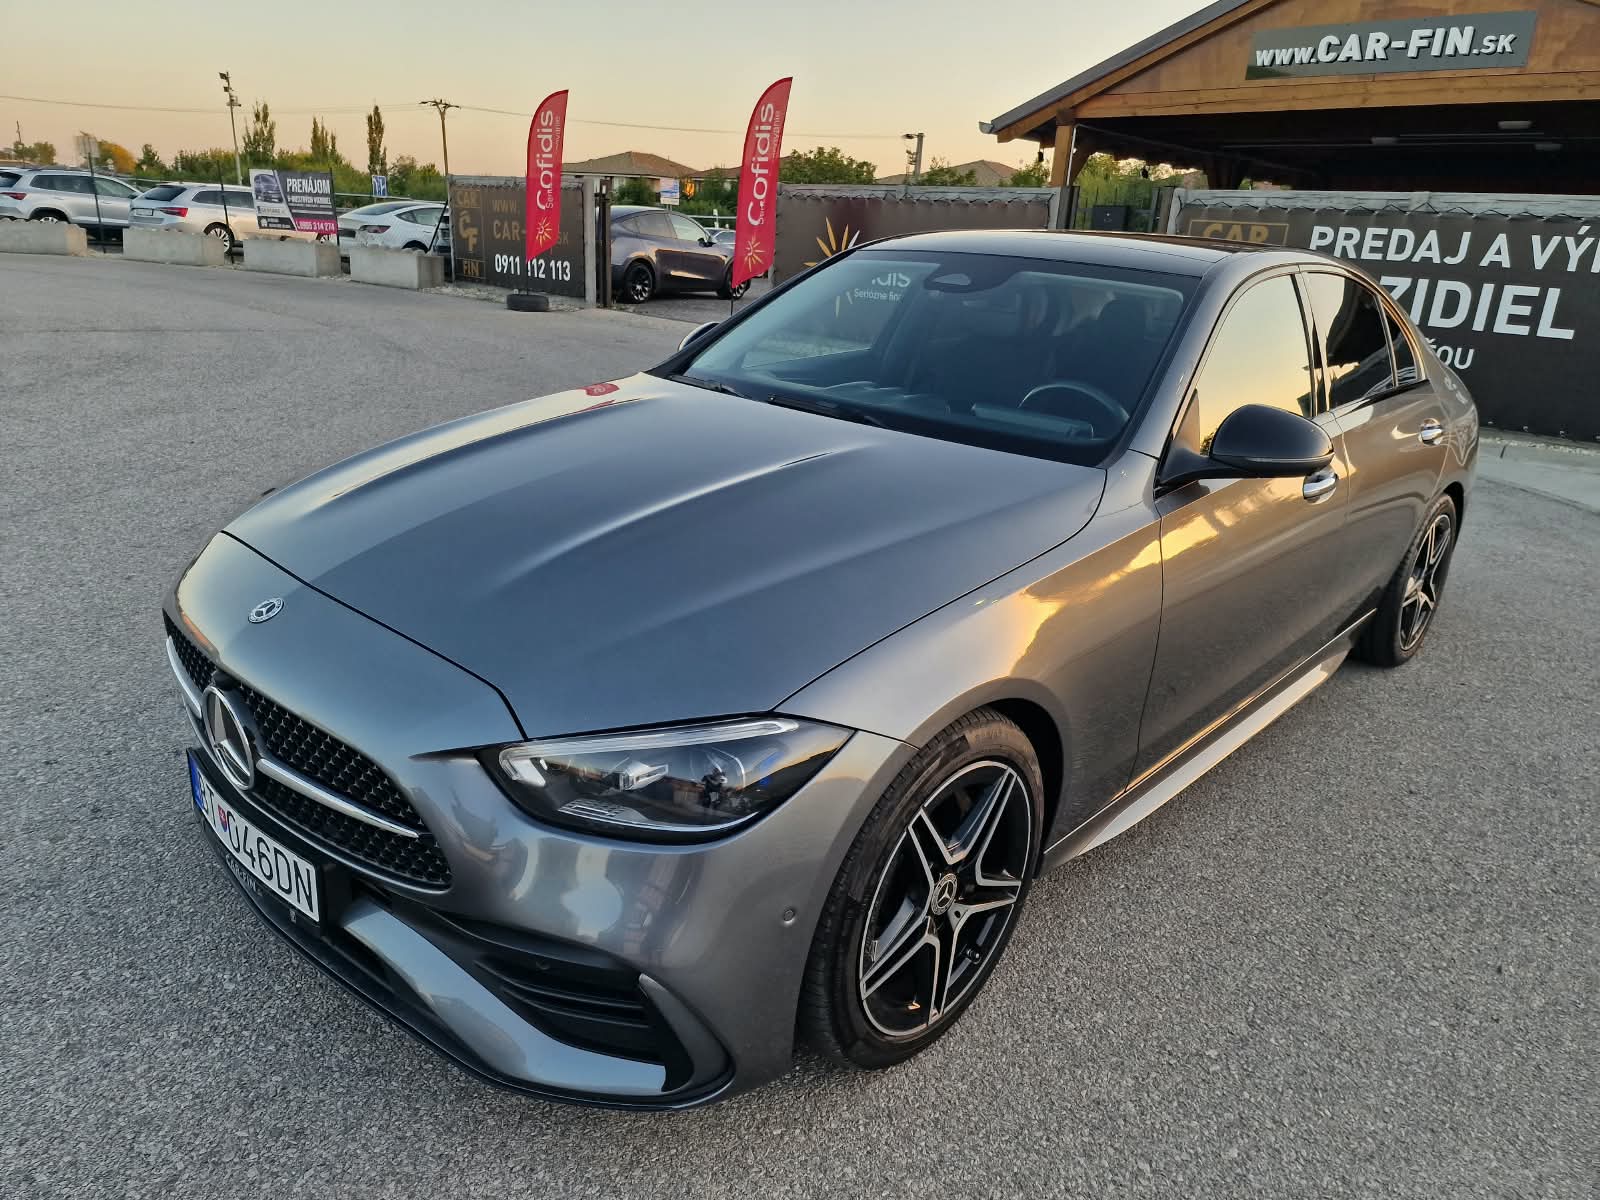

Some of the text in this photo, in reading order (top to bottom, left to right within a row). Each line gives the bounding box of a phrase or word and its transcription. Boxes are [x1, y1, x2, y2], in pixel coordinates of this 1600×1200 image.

[536, 109, 554, 211] Cofidis
[747, 102, 774, 226] Cofidis
[286, 176, 331, 194] PRENÁJOM
[455, 190, 478, 208] CAR
[1309, 225, 1472, 265] PREDAJ
[1479, 233, 1511, 269] A
[463, 260, 480, 277] FIN
[494, 253, 521, 276] 0911
[549, 260, 571, 281] 113
